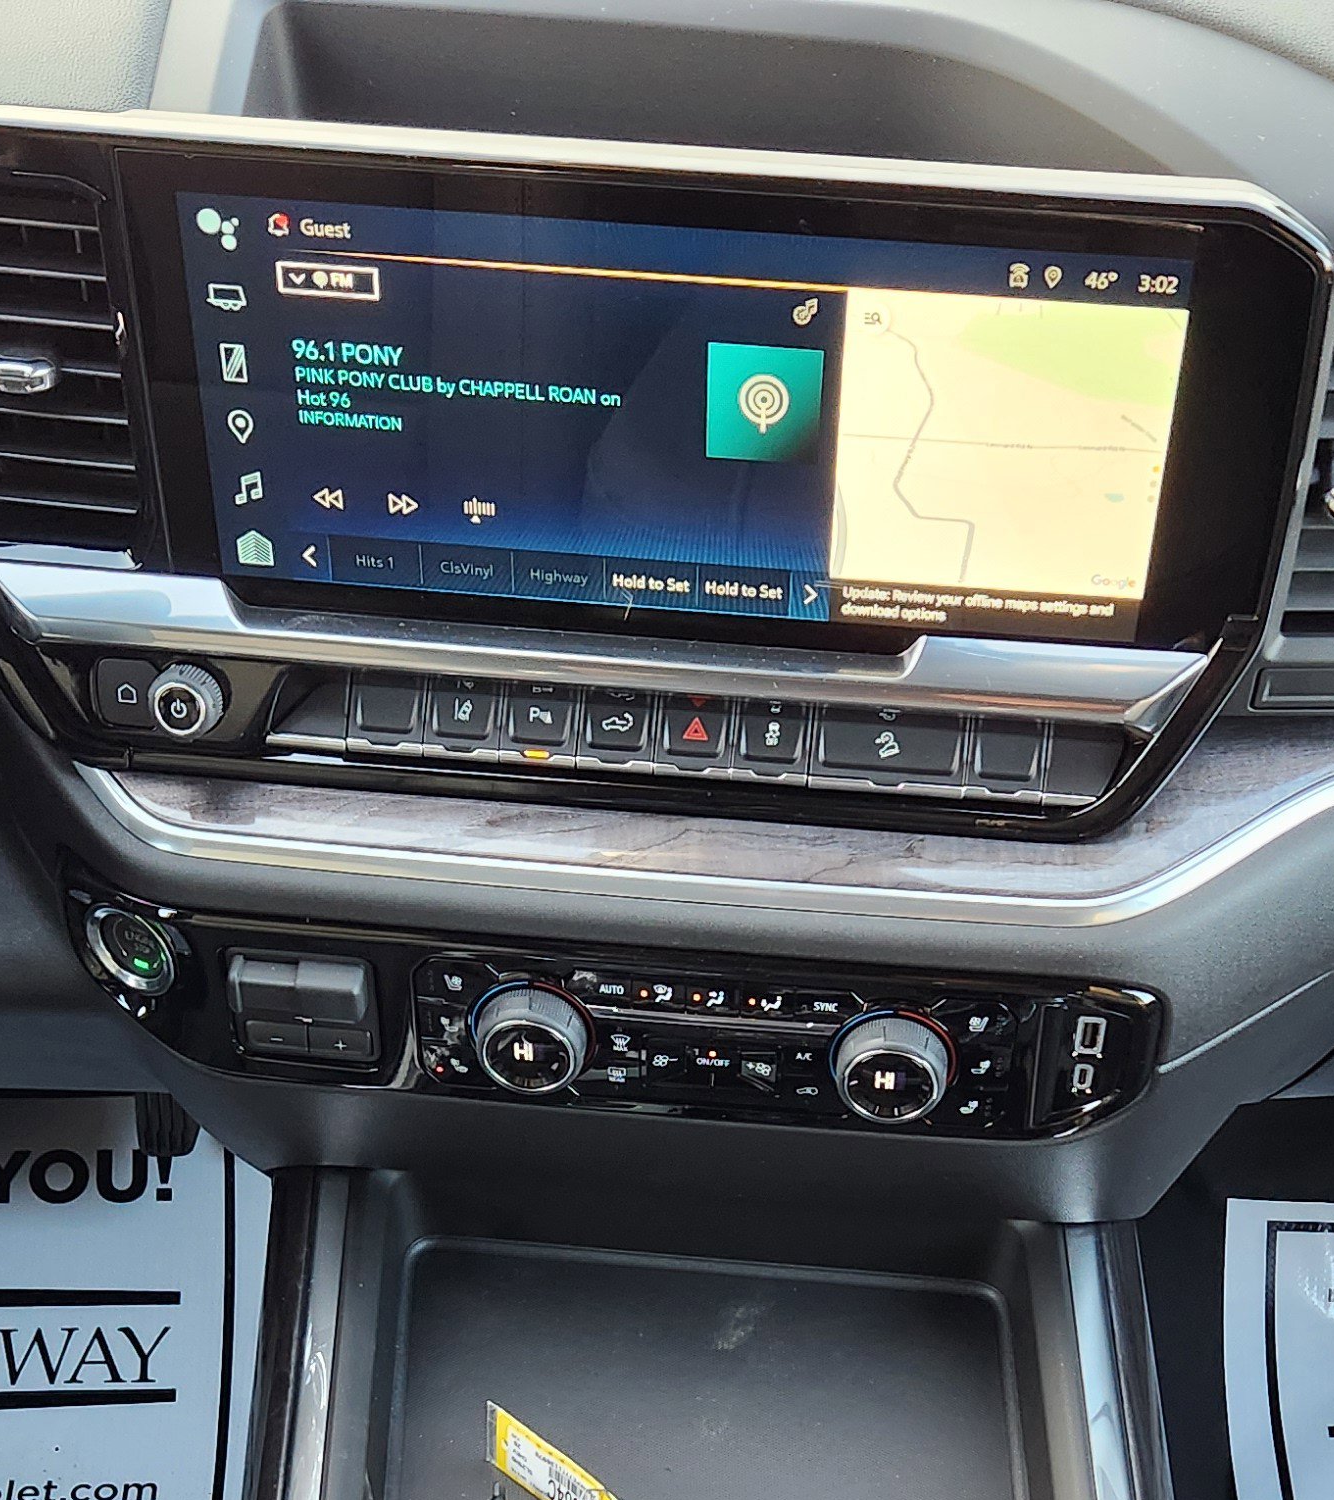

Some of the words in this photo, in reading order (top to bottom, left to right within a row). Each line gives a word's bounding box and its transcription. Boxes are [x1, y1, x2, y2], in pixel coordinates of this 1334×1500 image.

[300, 218, 351, 239] Guest
[329, 272, 353, 289] FM
[1138, 274, 1179, 295] 3:02
[292, 339, 335, 362] 96.1
[341, 342, 403, 367] PONY
[295, 366, 335, 385] PINK
[338, 369, 385, 389] PONY
[388, 374, 433, 392] CLUB
[437, 376, 456, 398] by
[459, 379, 545, 401] CHAPPELL
[549, 386, 596, 404] ROAN
[600, 393, 621, 406] on
[297, 389, 327, 407] Hot
[329, 391, 351, 408] 96
[298, 409, 402, 431] INFORMATION
[356, 554, 384, 569] Hits
[530, 568, 589, 587] Highway
[612, 573, 645, 590] Hold
[648, 577, 664, 591] to
[667, 577, 691, 593] Set
[1091, 574, 1136, 590] Google
[705, 580, 738, 597] Hold
[741, 584, 757, 598] to
[759, 584, 784, 600] Set
[842, 586, 891, 601] Update:
[892, 589, 935, 605] Review
[935, 594, 964, 608] your
[1005, 599, 1039, 614] maps
[1039, 600, 1089, 617] settings
[1089, 602, 1115, 617] and
[841, 601, 901, 619] download
[900, 606, 947, 622] options
[599, 984, 624, 995] AUTO
[813, 1001, 838, 1013] SYNC
[514, 1042, 533, 1061] HI
[796, 1052, 812, 1061] A/C
[696, 1057, 730, 1068] ON/OFF
[874, 1071, 895, 1090] HI
